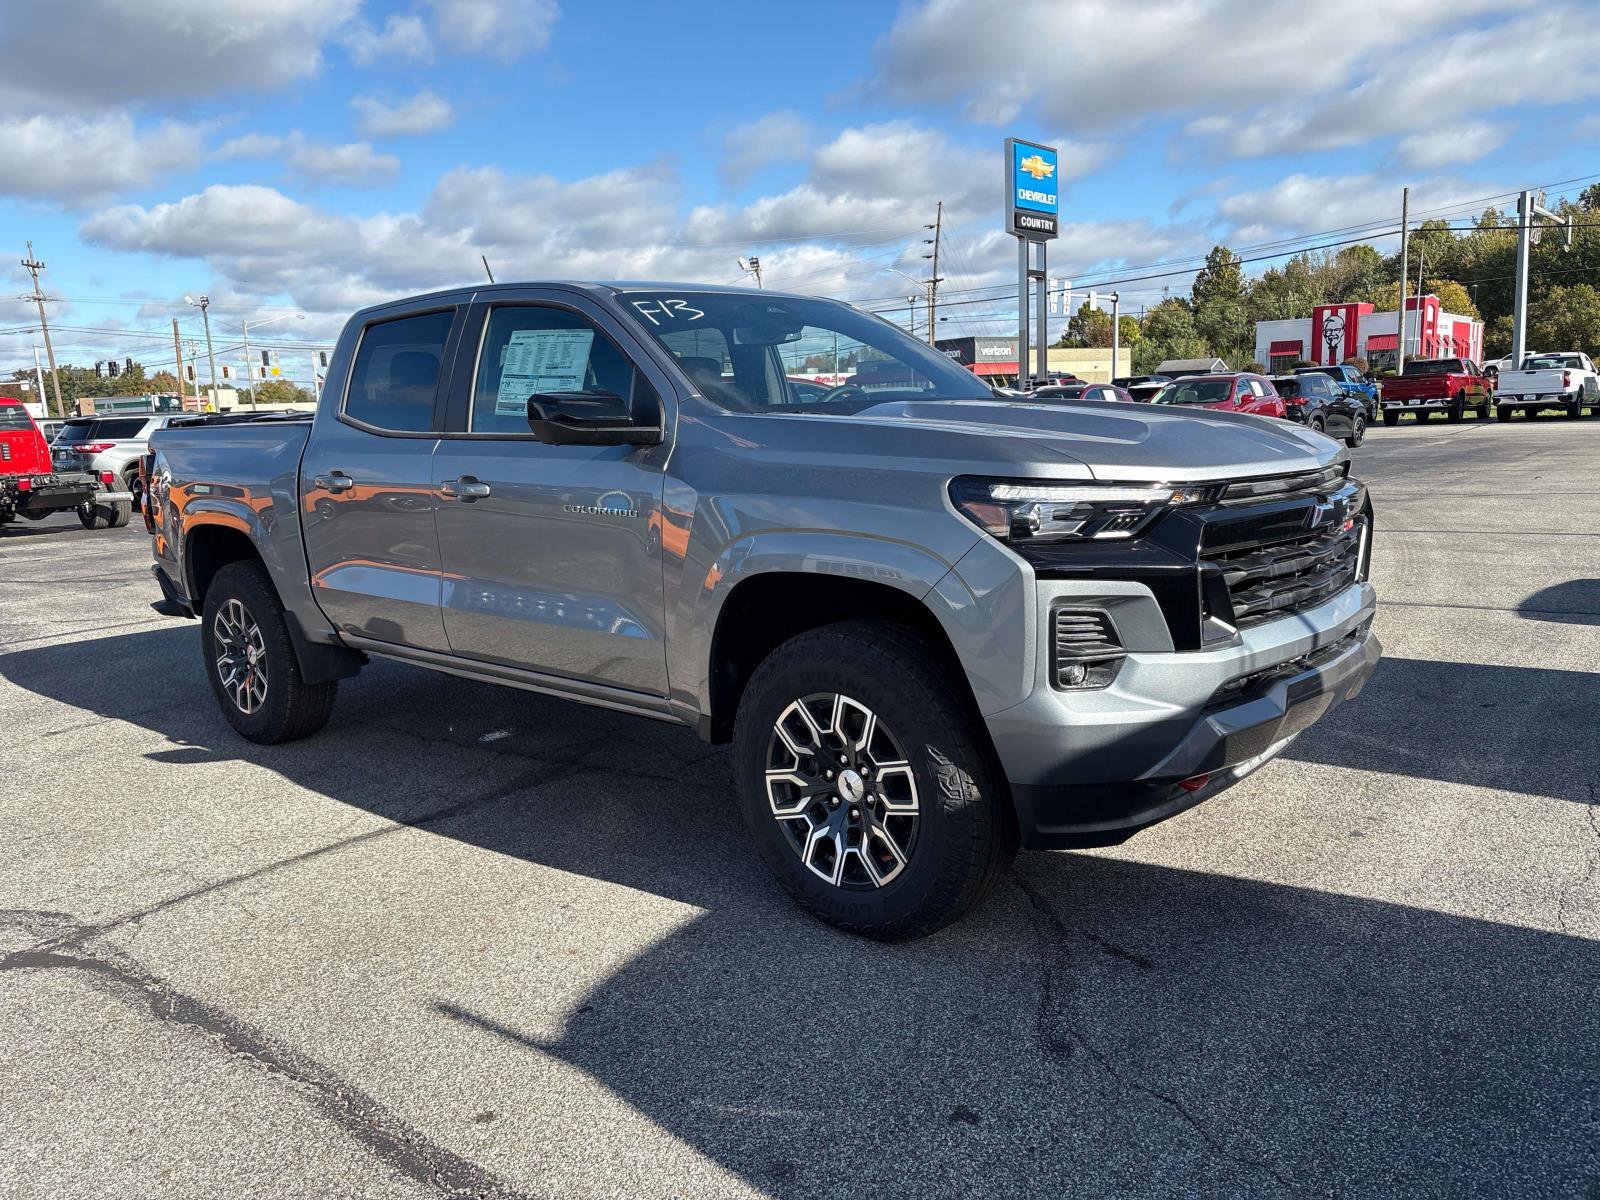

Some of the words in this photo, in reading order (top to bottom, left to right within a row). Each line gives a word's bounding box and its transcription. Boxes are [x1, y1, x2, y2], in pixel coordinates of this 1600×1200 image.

[1018, 188, 1057, 205] CHEVROLET
[1021, 216, 1054, 231] COUNTRY
[630, 299, 705, 326] F13
[980, 345, 1012, 356] verizon
[563, 504, 638, 518] COLORADO
